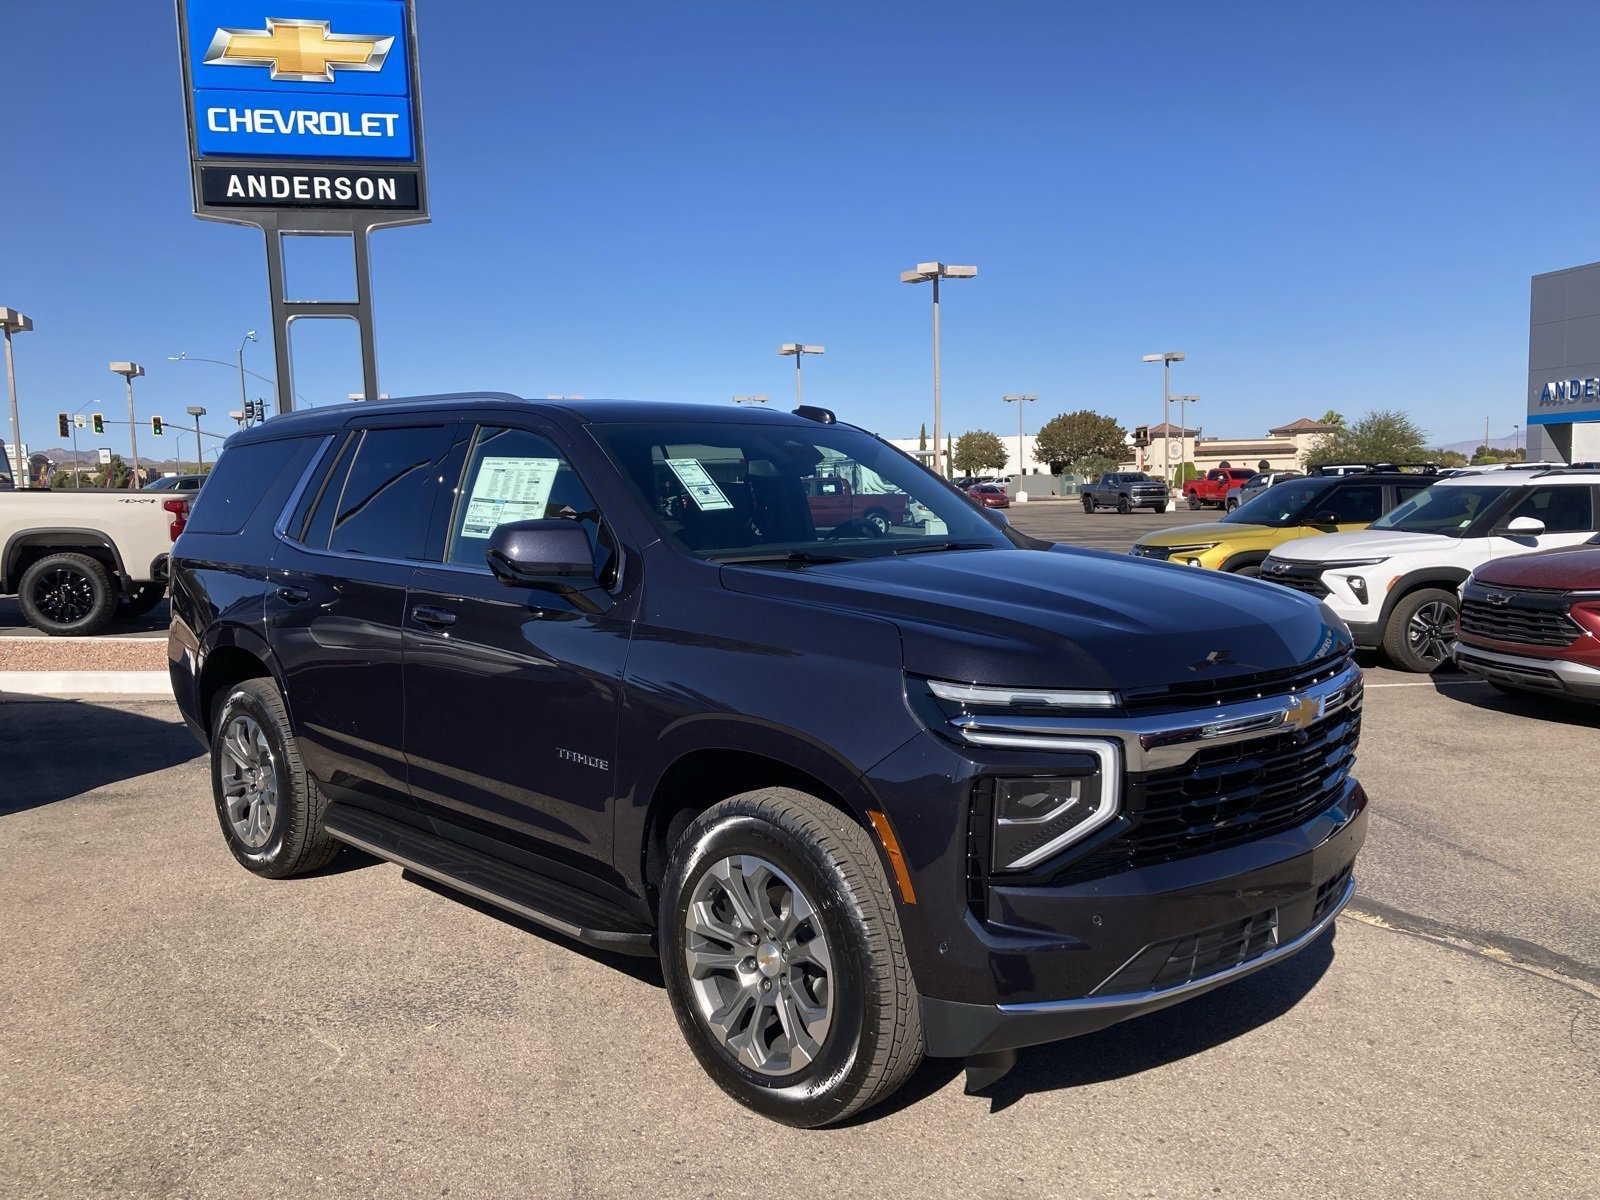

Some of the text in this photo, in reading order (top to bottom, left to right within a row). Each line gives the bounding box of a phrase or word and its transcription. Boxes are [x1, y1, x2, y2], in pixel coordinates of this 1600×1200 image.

[207, 107, 399, 137] CHEVROLET
[226, 174, 397, 201] ANDERSON
[1541, 378, 1600, 401] ANDE
[555, 747, 609, 771] TAHOE
